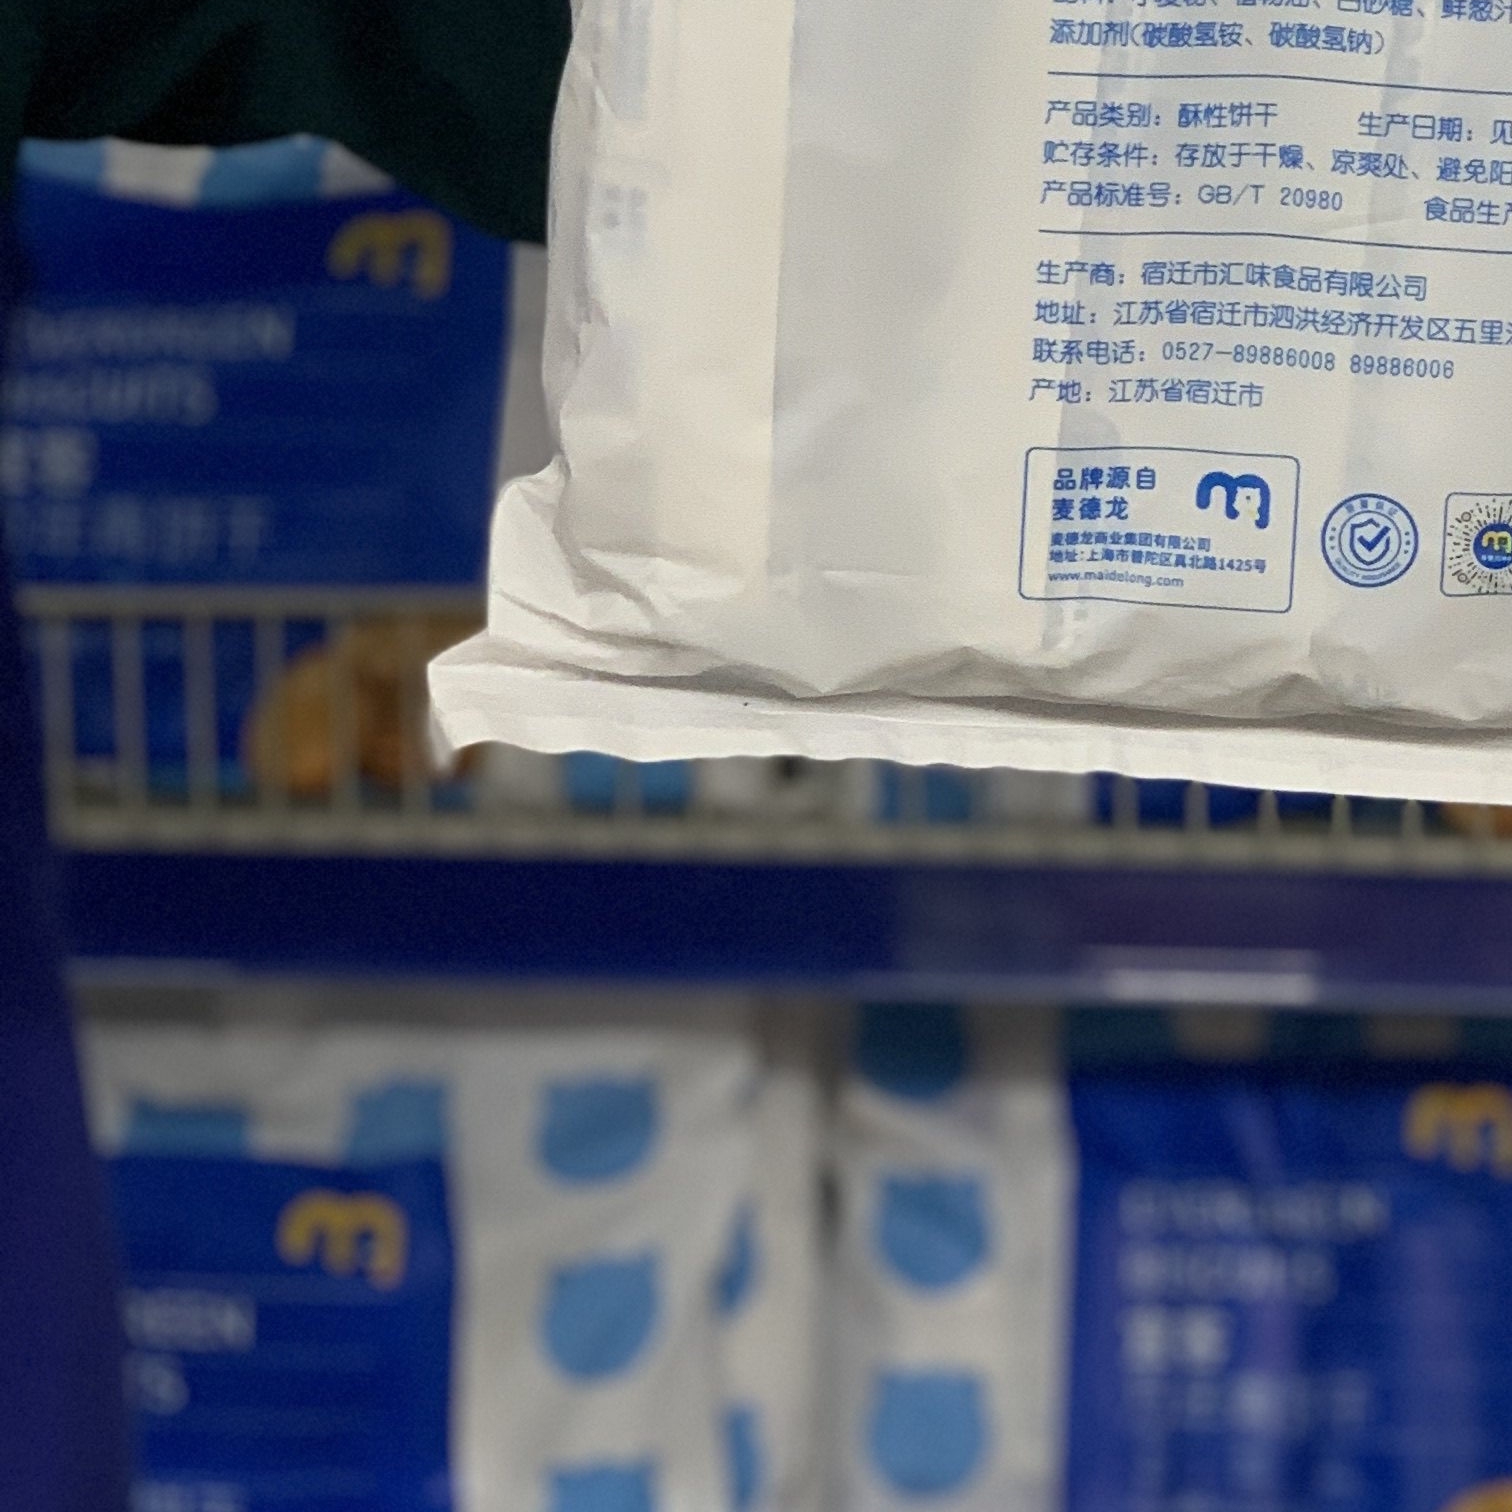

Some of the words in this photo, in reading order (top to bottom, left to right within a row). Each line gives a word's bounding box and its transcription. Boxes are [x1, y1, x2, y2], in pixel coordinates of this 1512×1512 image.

[1279, 188, 1344, 213] 20980
[1349, 354, 1455, 380] 89886006
[1052, 466, 1157, 491] 品牌源自
[1051, 496, 1129, 521] 麦德龙
[1048, 568, 1185, 588] www.maidelong.com
